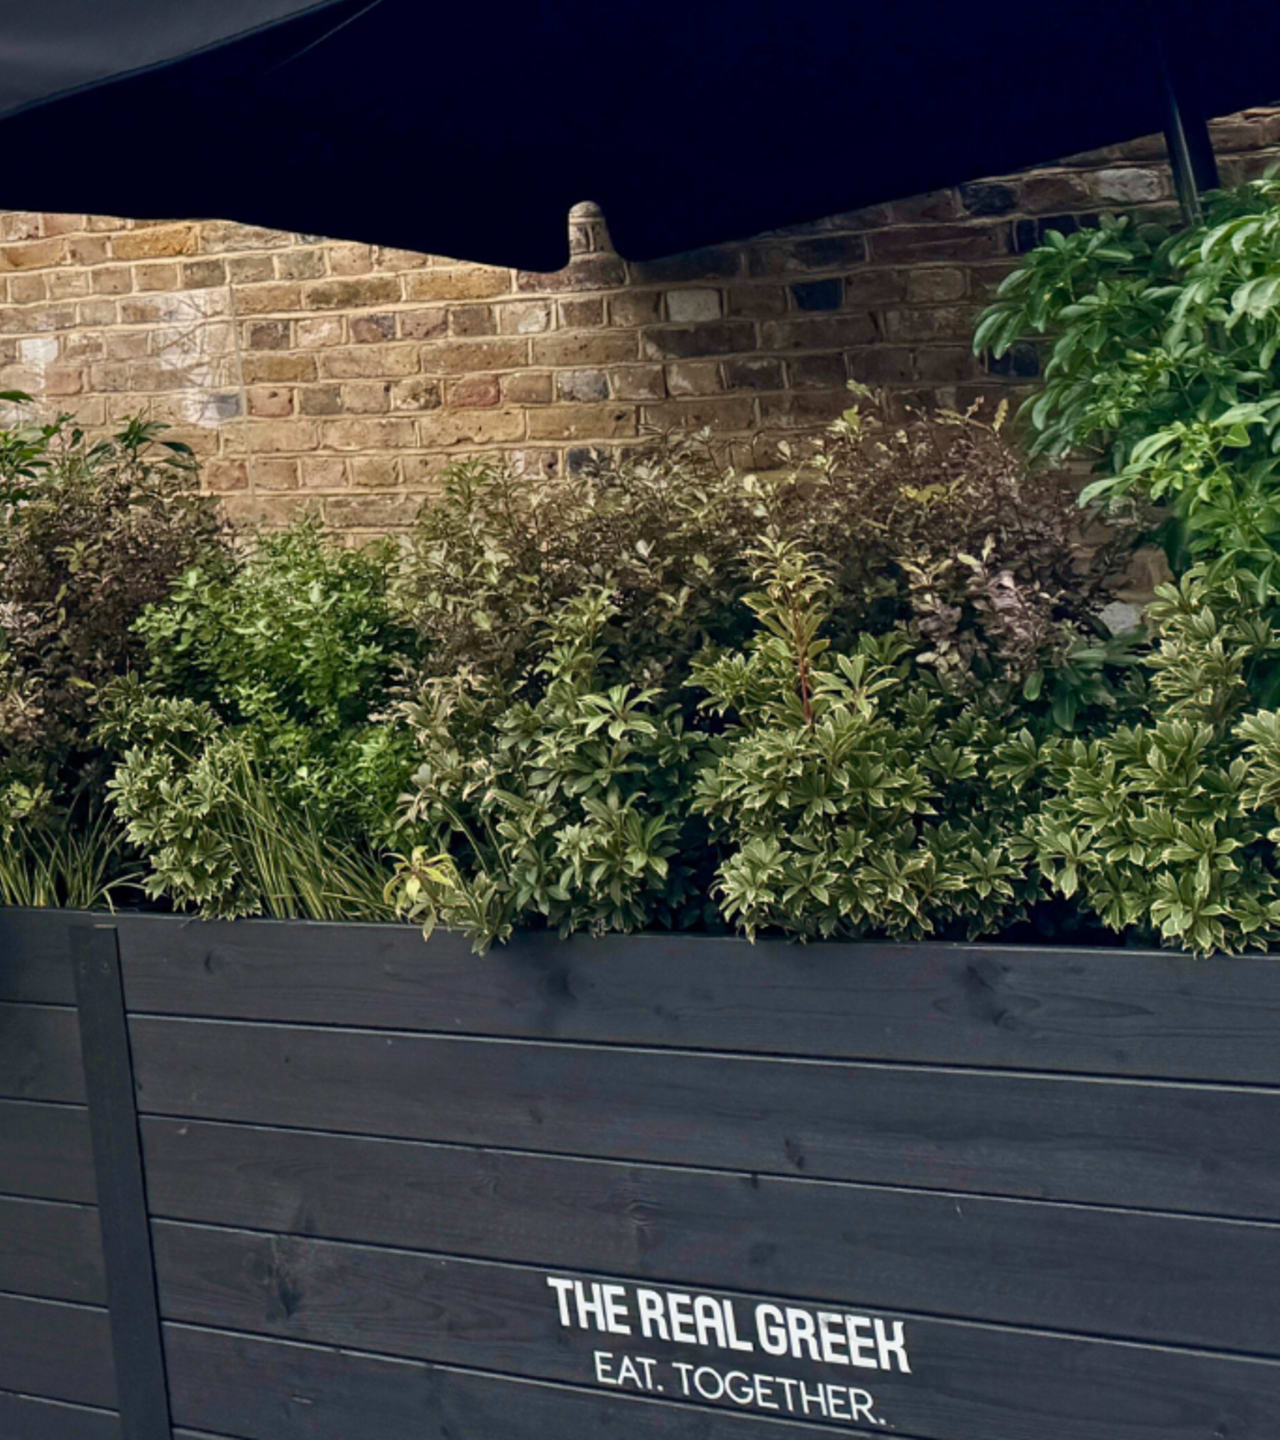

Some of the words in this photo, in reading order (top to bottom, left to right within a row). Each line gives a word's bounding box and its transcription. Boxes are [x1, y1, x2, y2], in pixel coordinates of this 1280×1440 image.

[547, 1276, 631, 1335] THE
[637, 1288, 754, 1352] REAL
[754, 1303, 912, 1374] GREEK
[594, 1350, 664, 1392] EAT.
[672, 1361, 887, 1425] TOGETHER.
